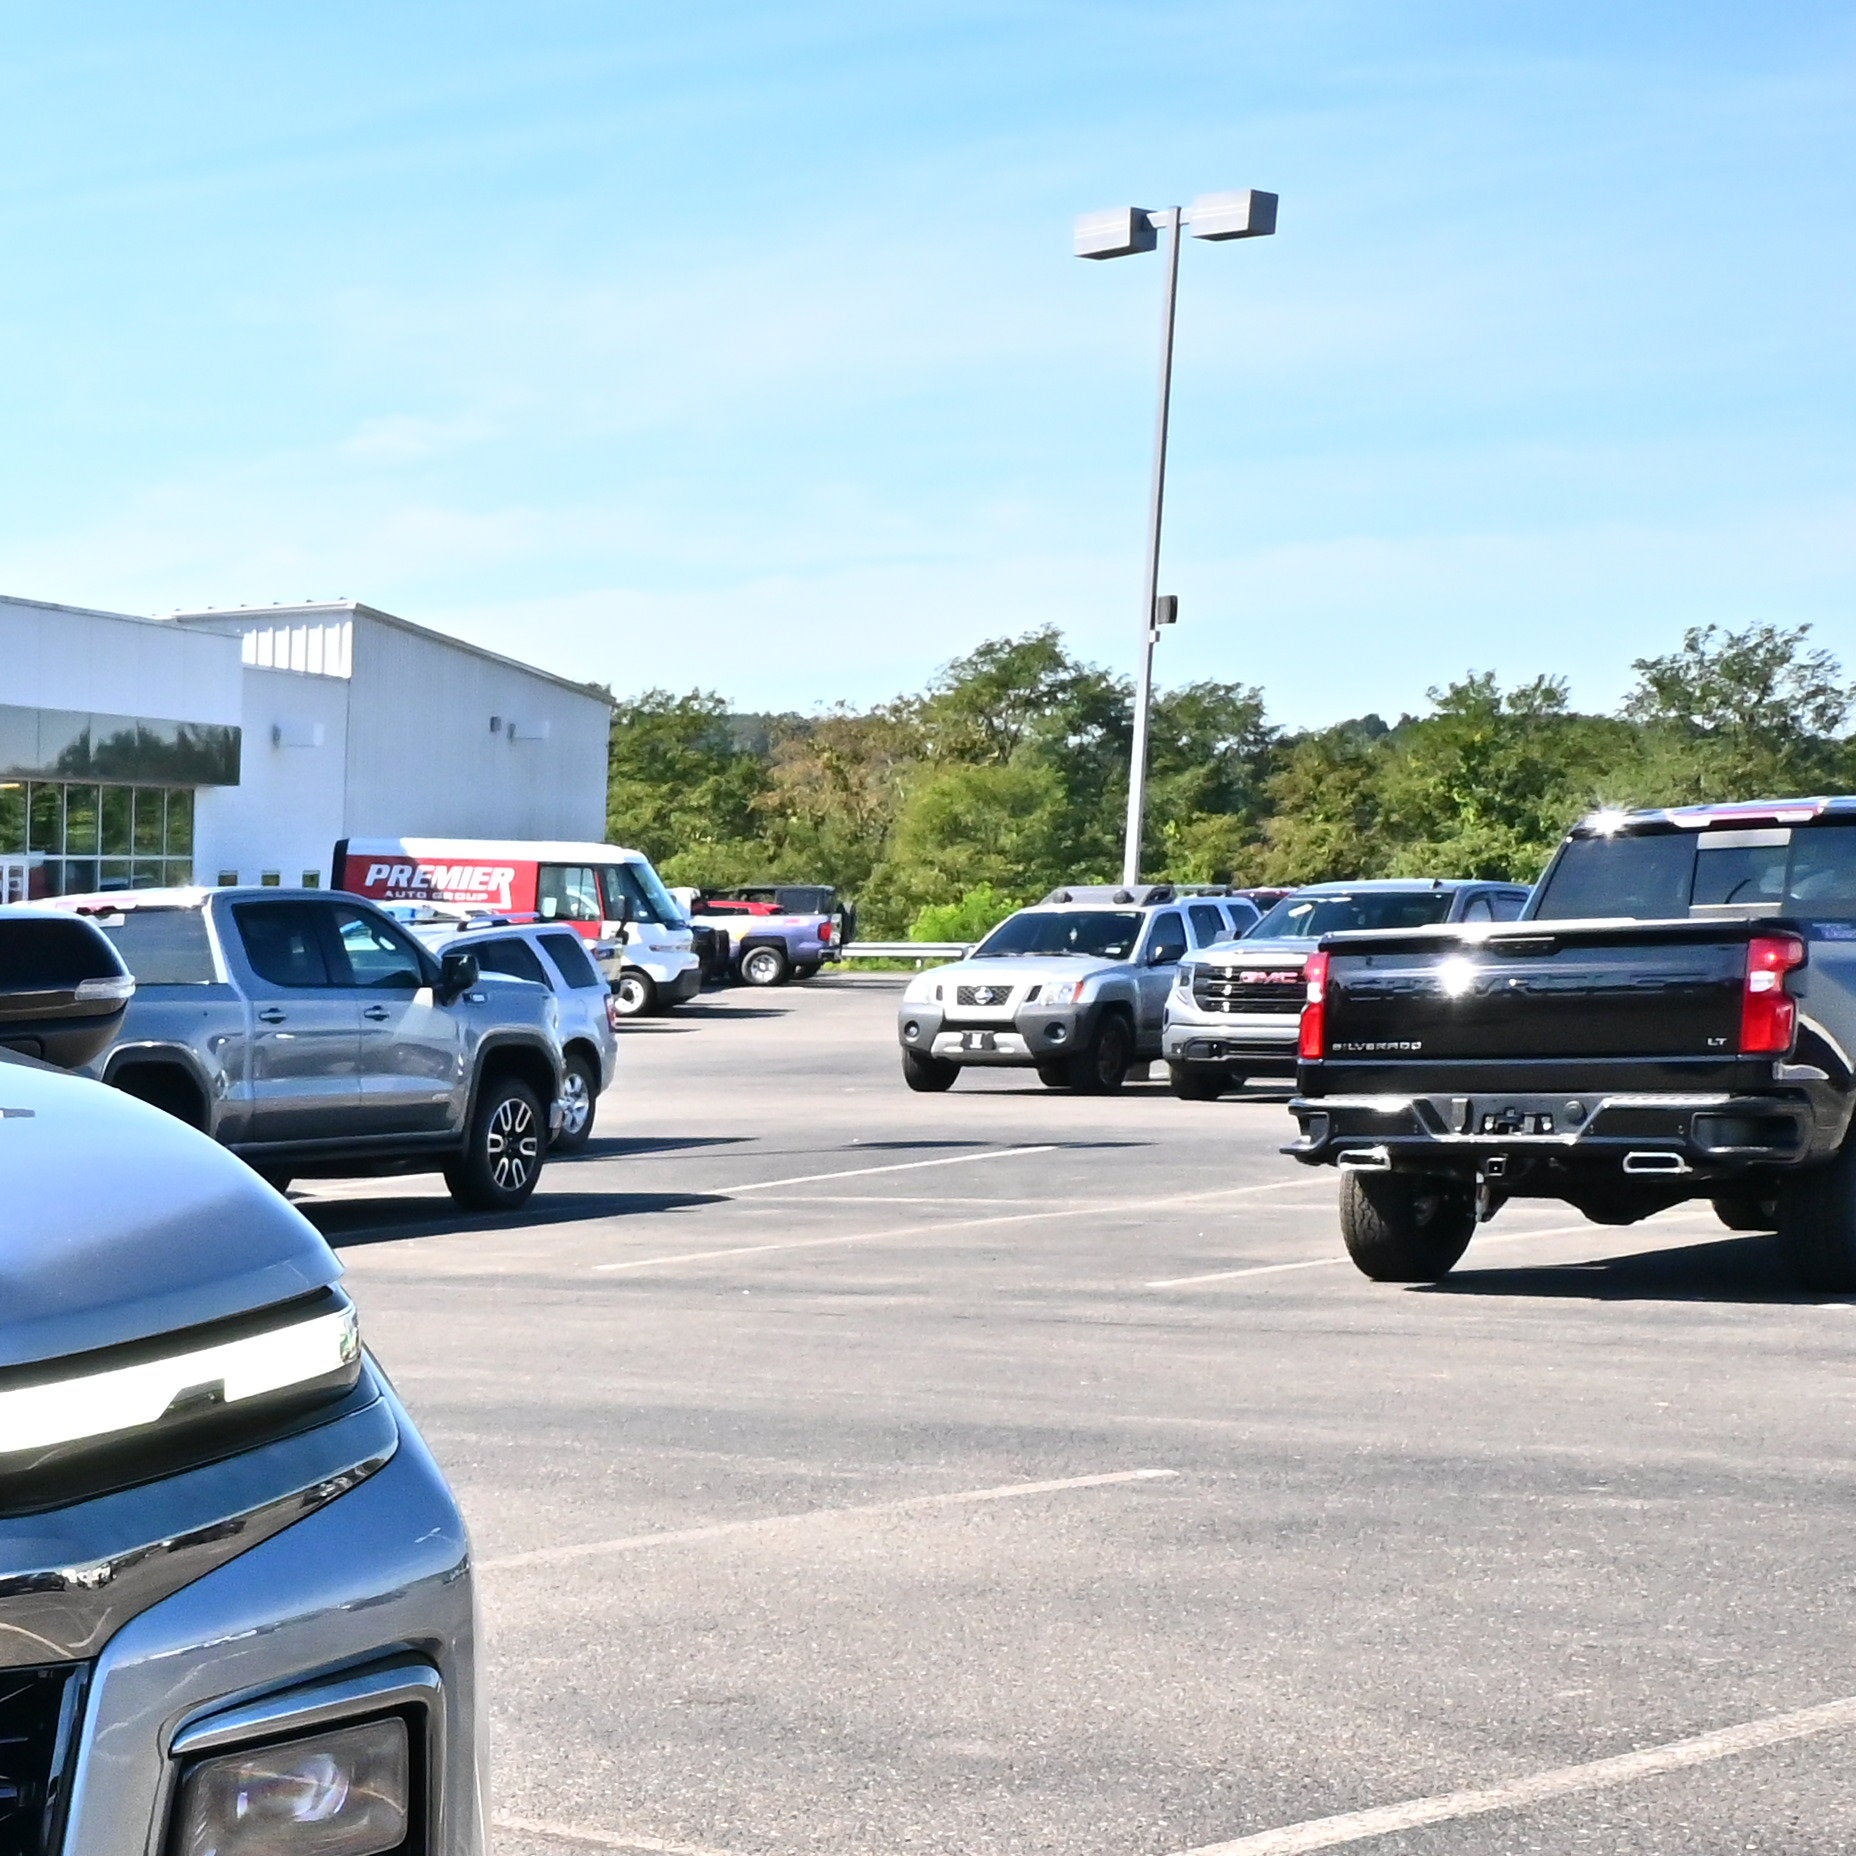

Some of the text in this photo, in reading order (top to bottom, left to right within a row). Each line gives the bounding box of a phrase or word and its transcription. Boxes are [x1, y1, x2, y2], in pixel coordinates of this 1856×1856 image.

[364, 863, 515, 894] PREMIER
[384, 890, 488, 901] AUTO GROUP
[1239, 971, 1299, 984] GMC
[1331, 1041, 1422, 1051] SILVERADO
[1707, 1037, 1728, 1046] LT
